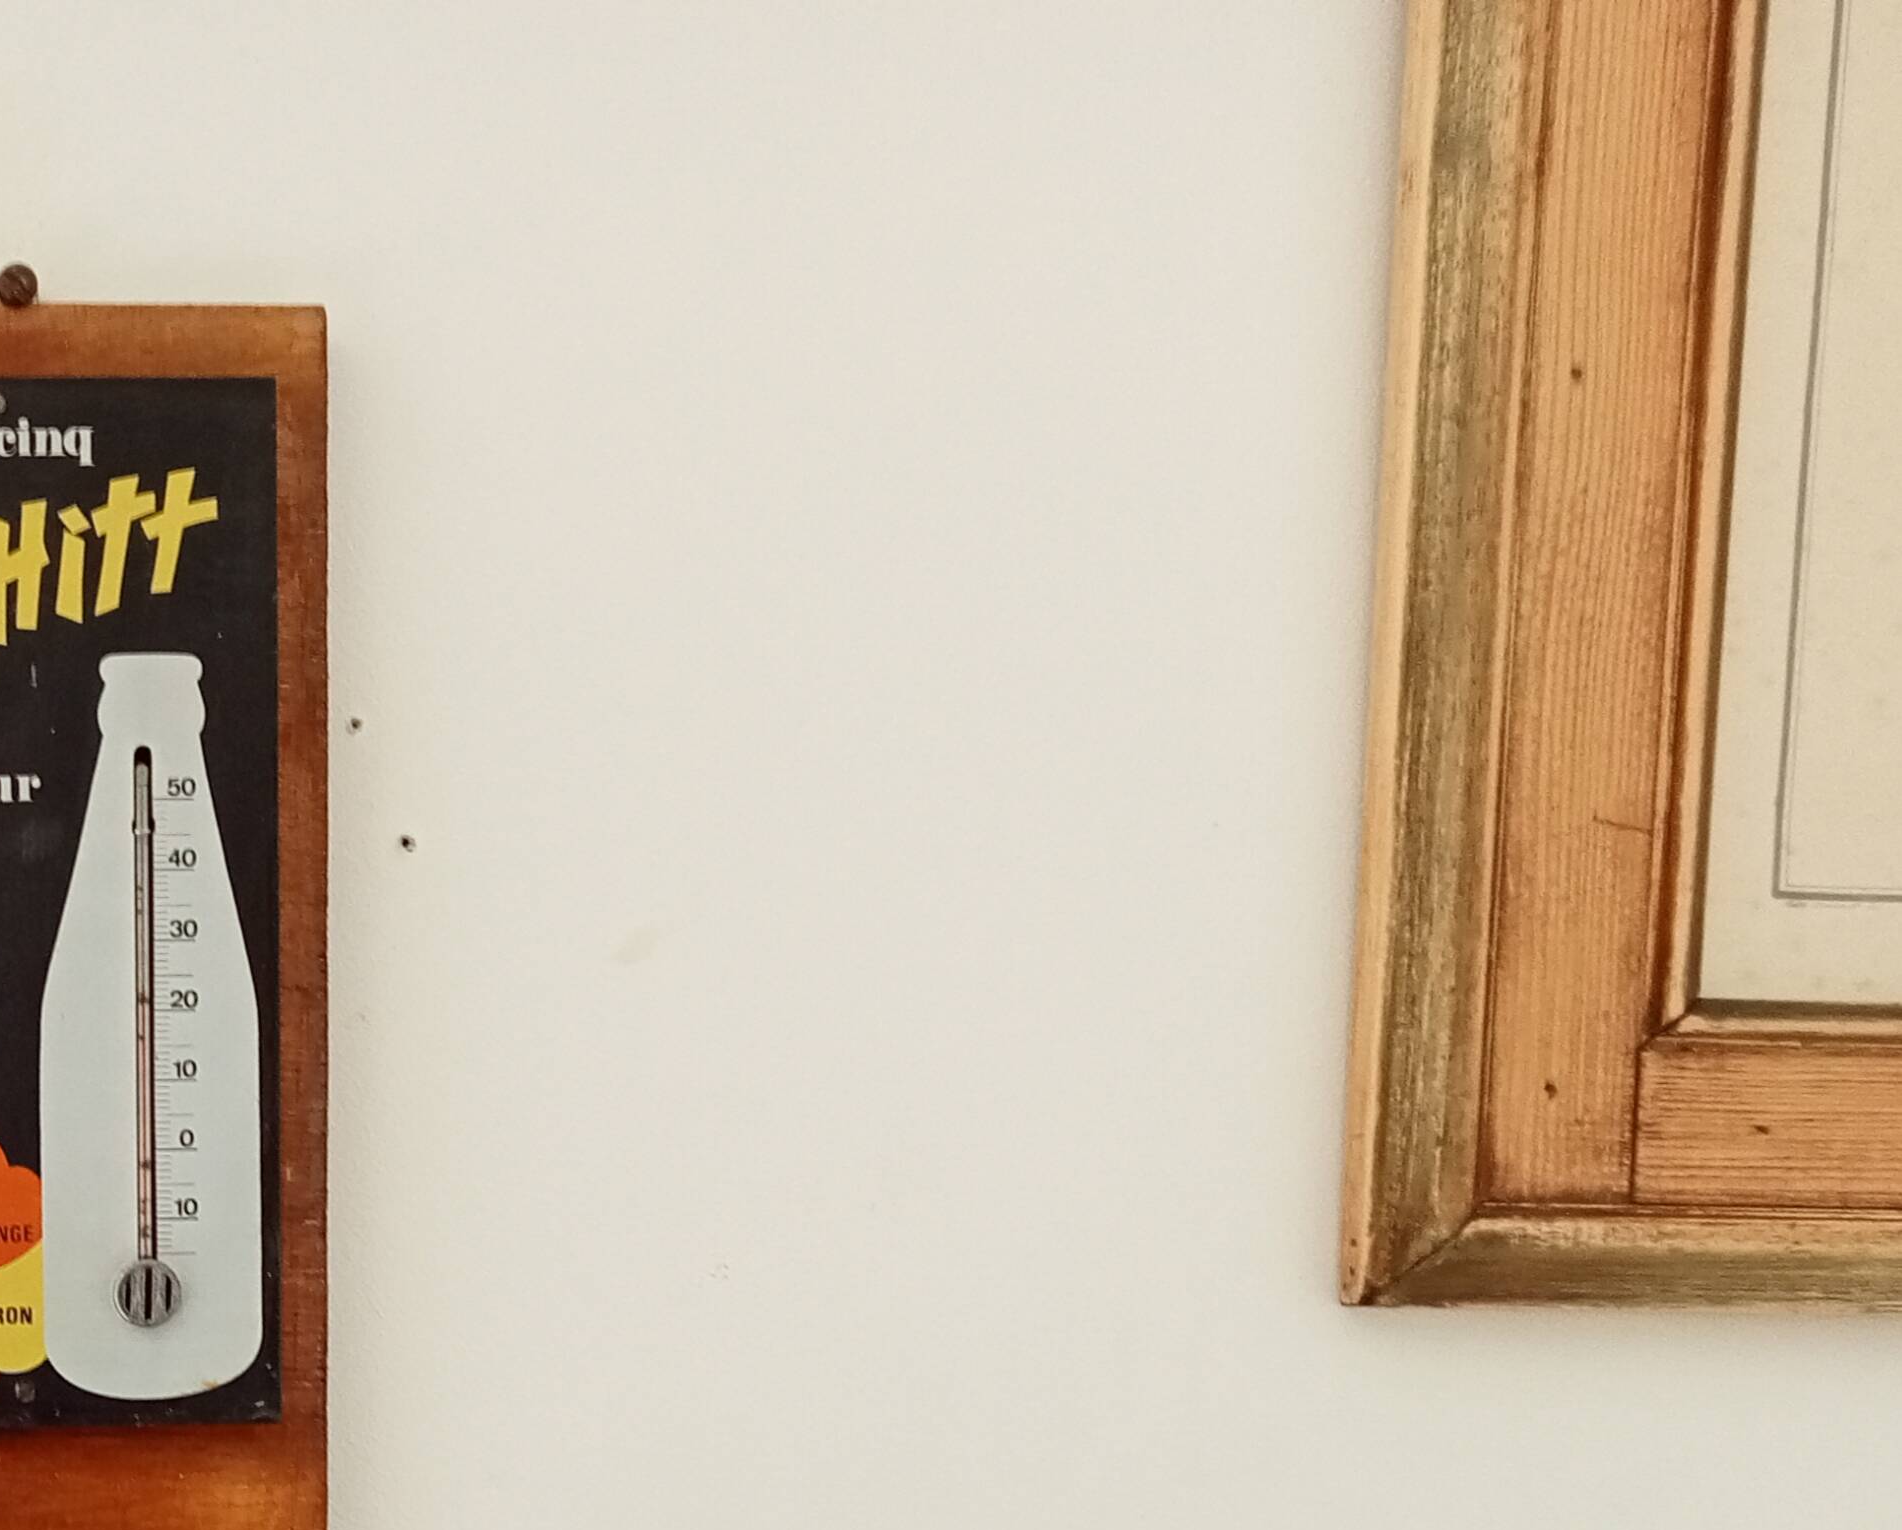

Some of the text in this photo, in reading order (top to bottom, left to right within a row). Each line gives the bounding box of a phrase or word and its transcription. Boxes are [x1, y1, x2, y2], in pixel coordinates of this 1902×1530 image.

[167, 777, 197, 797] 50
[168, 849, 197, 868] 40
[168, 919, 198, 938] 30
[169, 990, 198, 1009] 20
[173, 1060, 197, 1078] 10
[179, 1129, 194, 1147] 0
[174, 1198, 198, 1216] 10
